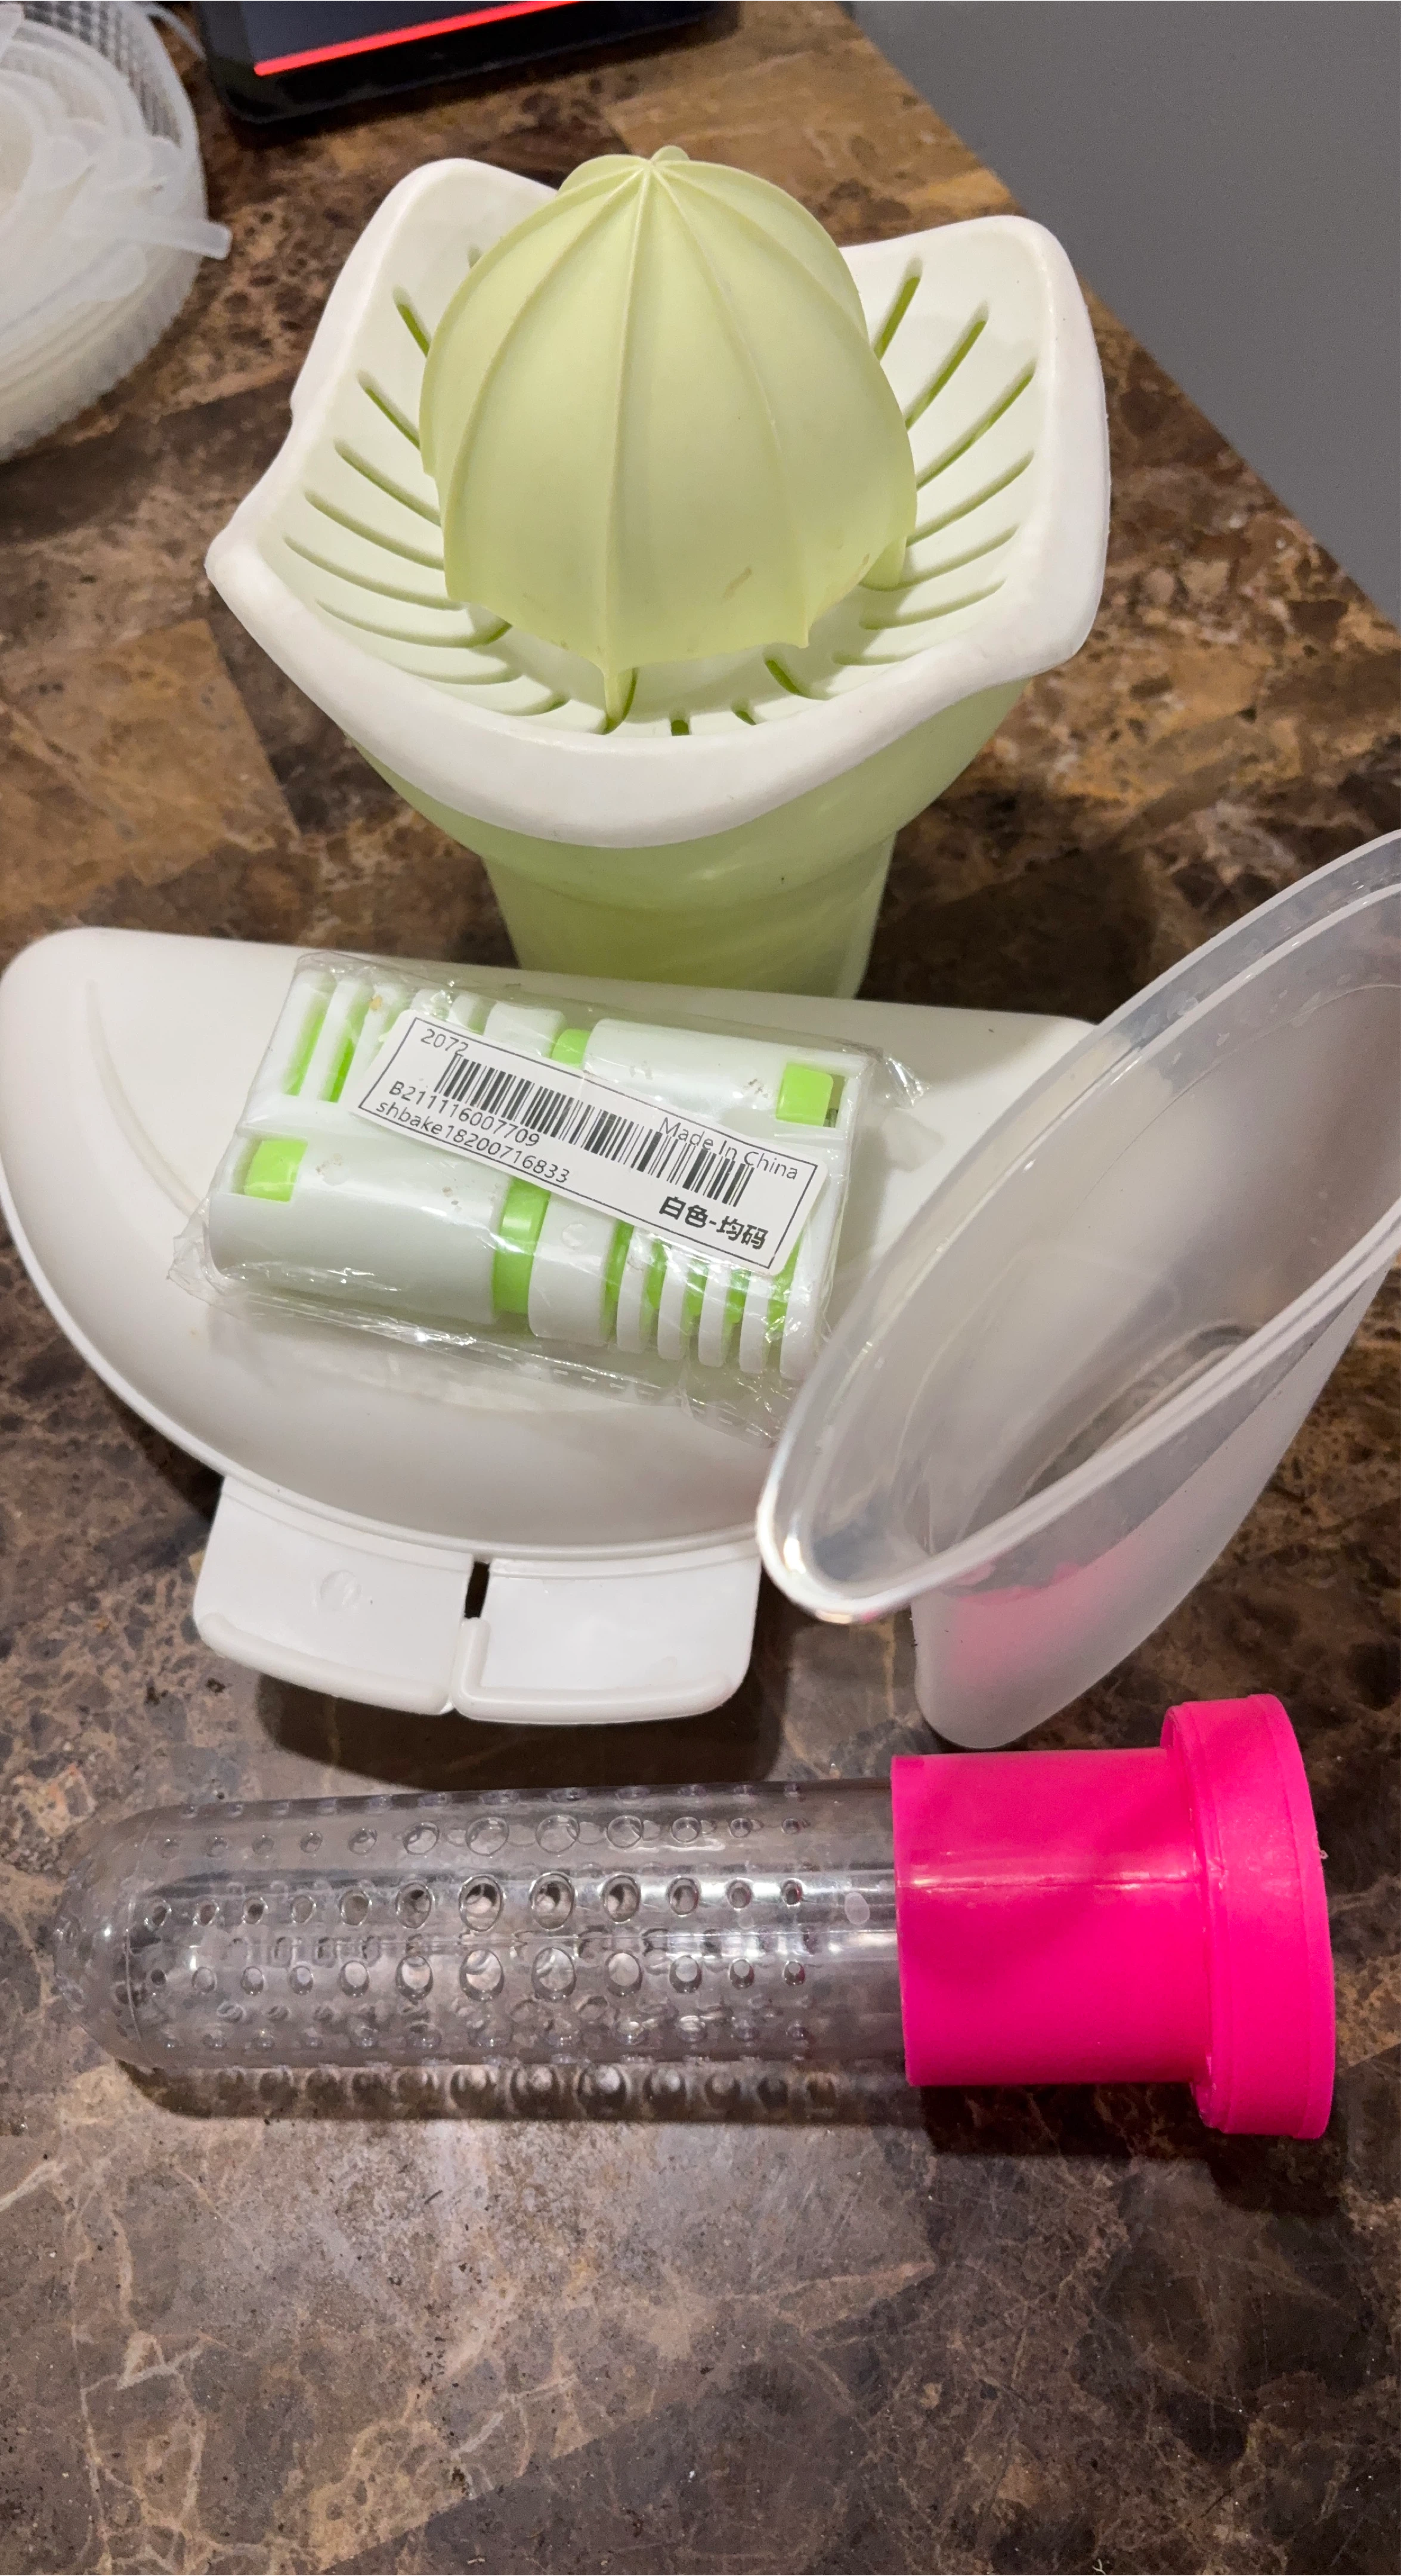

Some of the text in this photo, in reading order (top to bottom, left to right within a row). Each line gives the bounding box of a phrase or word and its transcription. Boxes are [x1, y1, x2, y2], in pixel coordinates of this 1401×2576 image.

[420, 1029, 469, 1057] 2072
[376, 1101, 570, 1184] shbake18200716833
[389, 1080, 540, 1147] B211116007709
[659, 1117, 798, 1180] Made In China
[658, 1196, 769, 1250] 白色-均码
